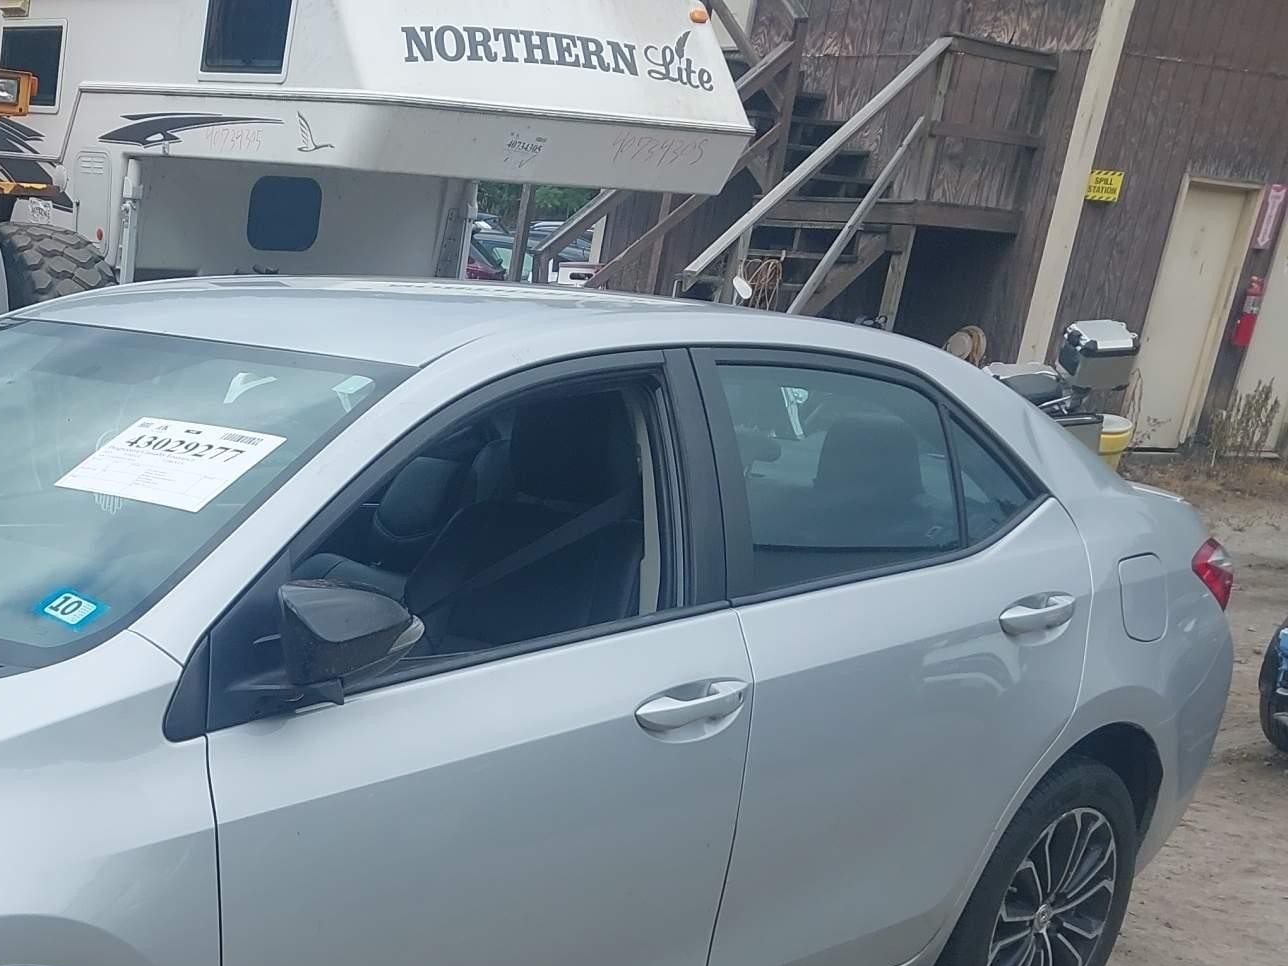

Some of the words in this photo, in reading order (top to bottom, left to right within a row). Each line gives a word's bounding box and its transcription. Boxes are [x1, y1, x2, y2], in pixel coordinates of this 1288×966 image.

[400, 25, 639, 76] NORTHERN
[644, 30, 714, 92] Lite
[1087, 186, 1117, 194] STATION
[1095, 176, 1113, 185] SPILL
[125, 434, 247, 463] 43029277
[48, 596, 83, 616] 10
